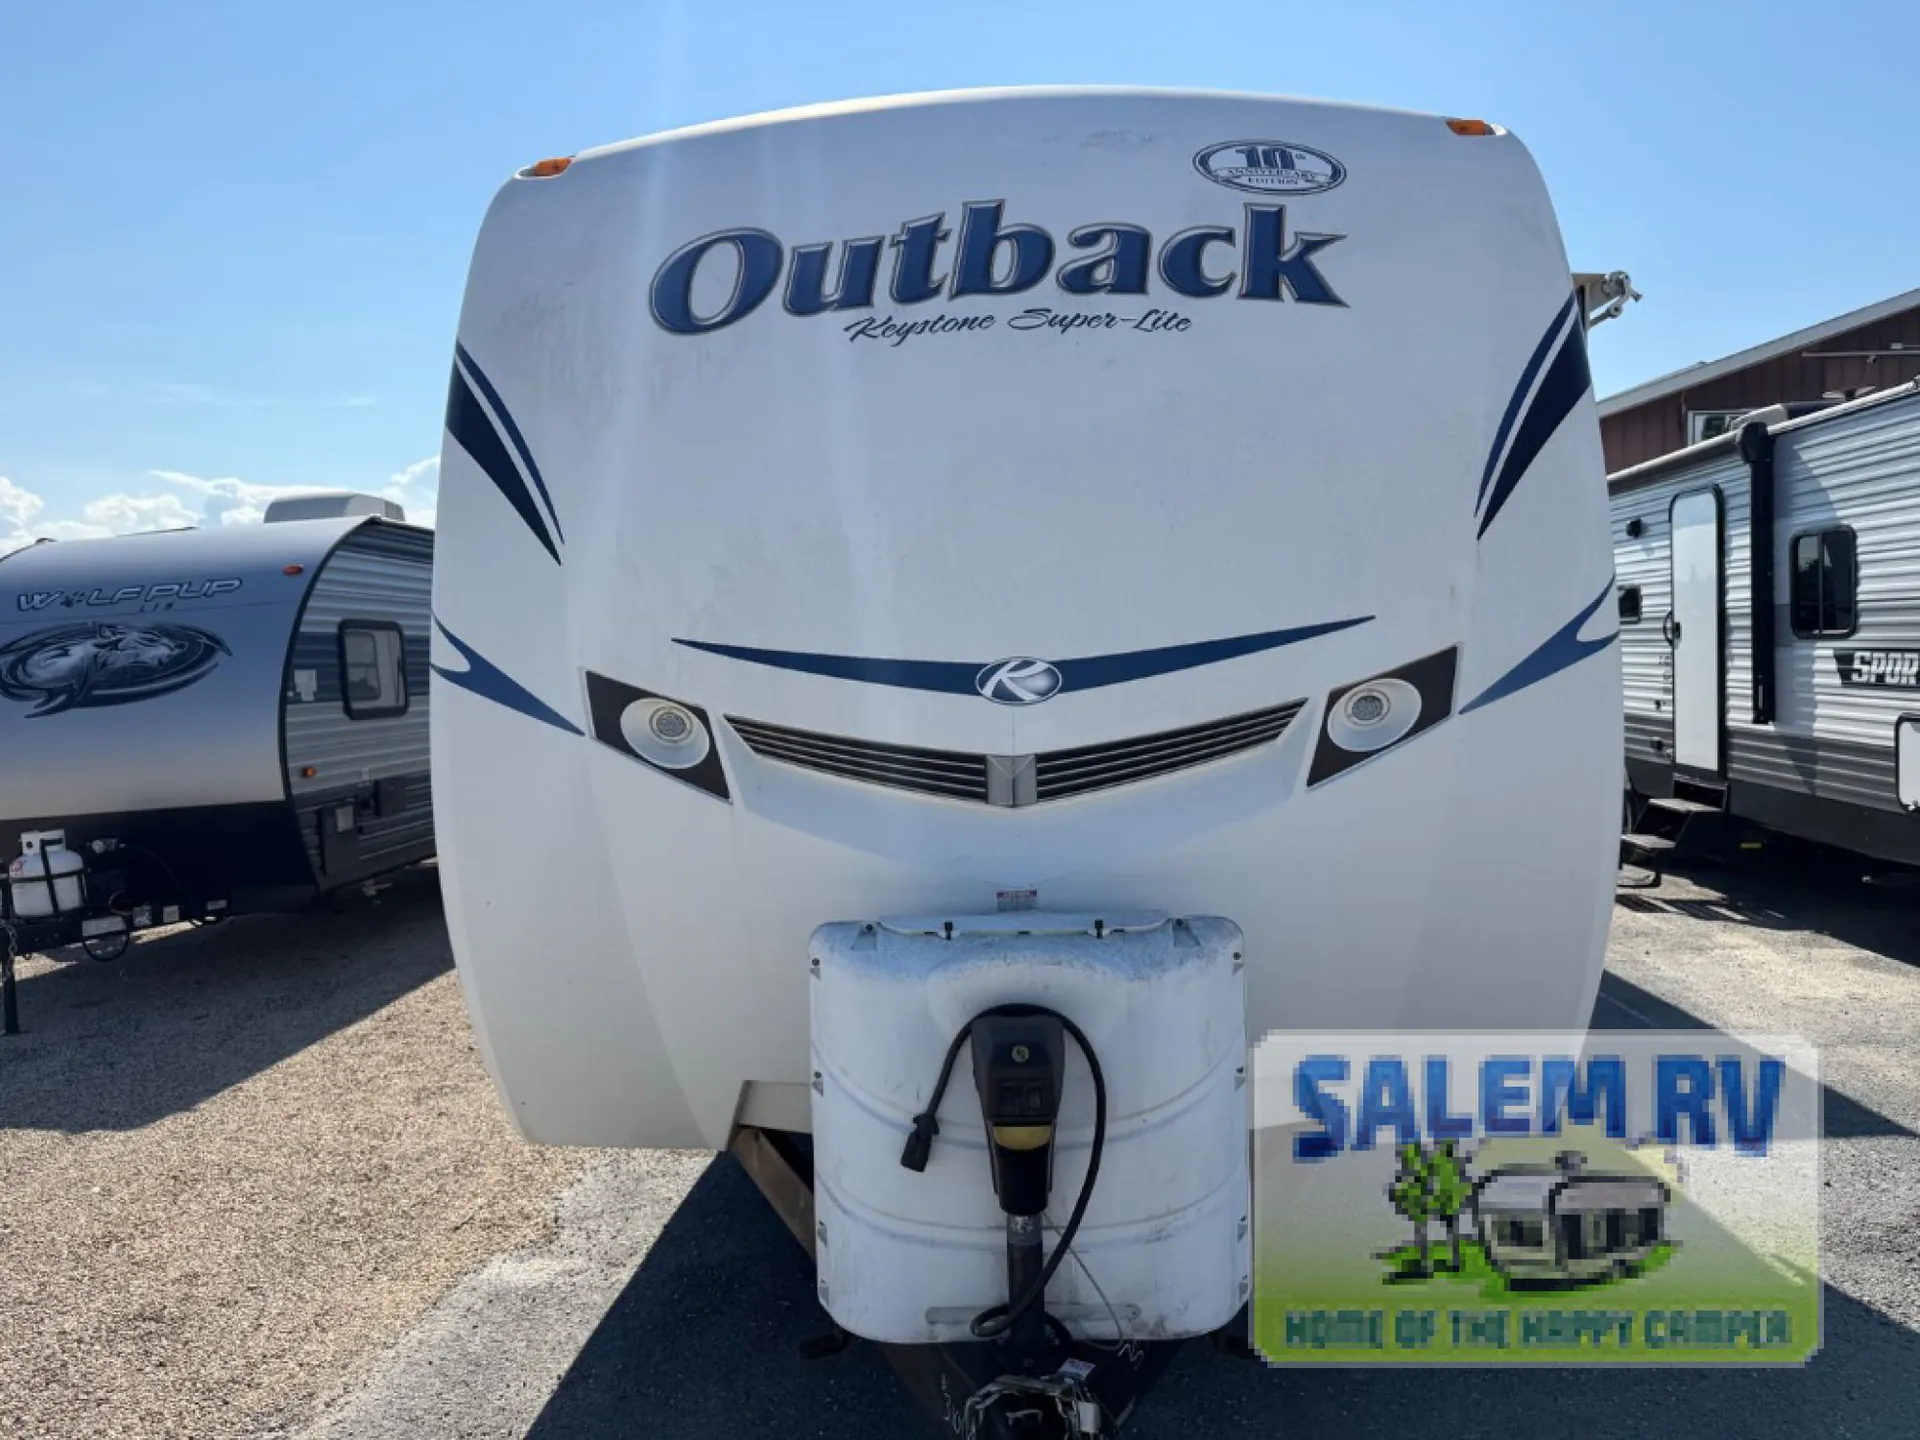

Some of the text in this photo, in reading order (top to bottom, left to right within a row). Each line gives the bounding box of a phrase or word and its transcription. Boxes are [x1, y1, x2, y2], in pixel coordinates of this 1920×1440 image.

[649, 199, 1350, 336] Outback
[843, 308, 1192, 347] Keystone Super-Lite
[17, 585, 144, 612] WLF
[143, 576, 243, 602] PUP
[1850, 651, 1919, 685] SPOR
